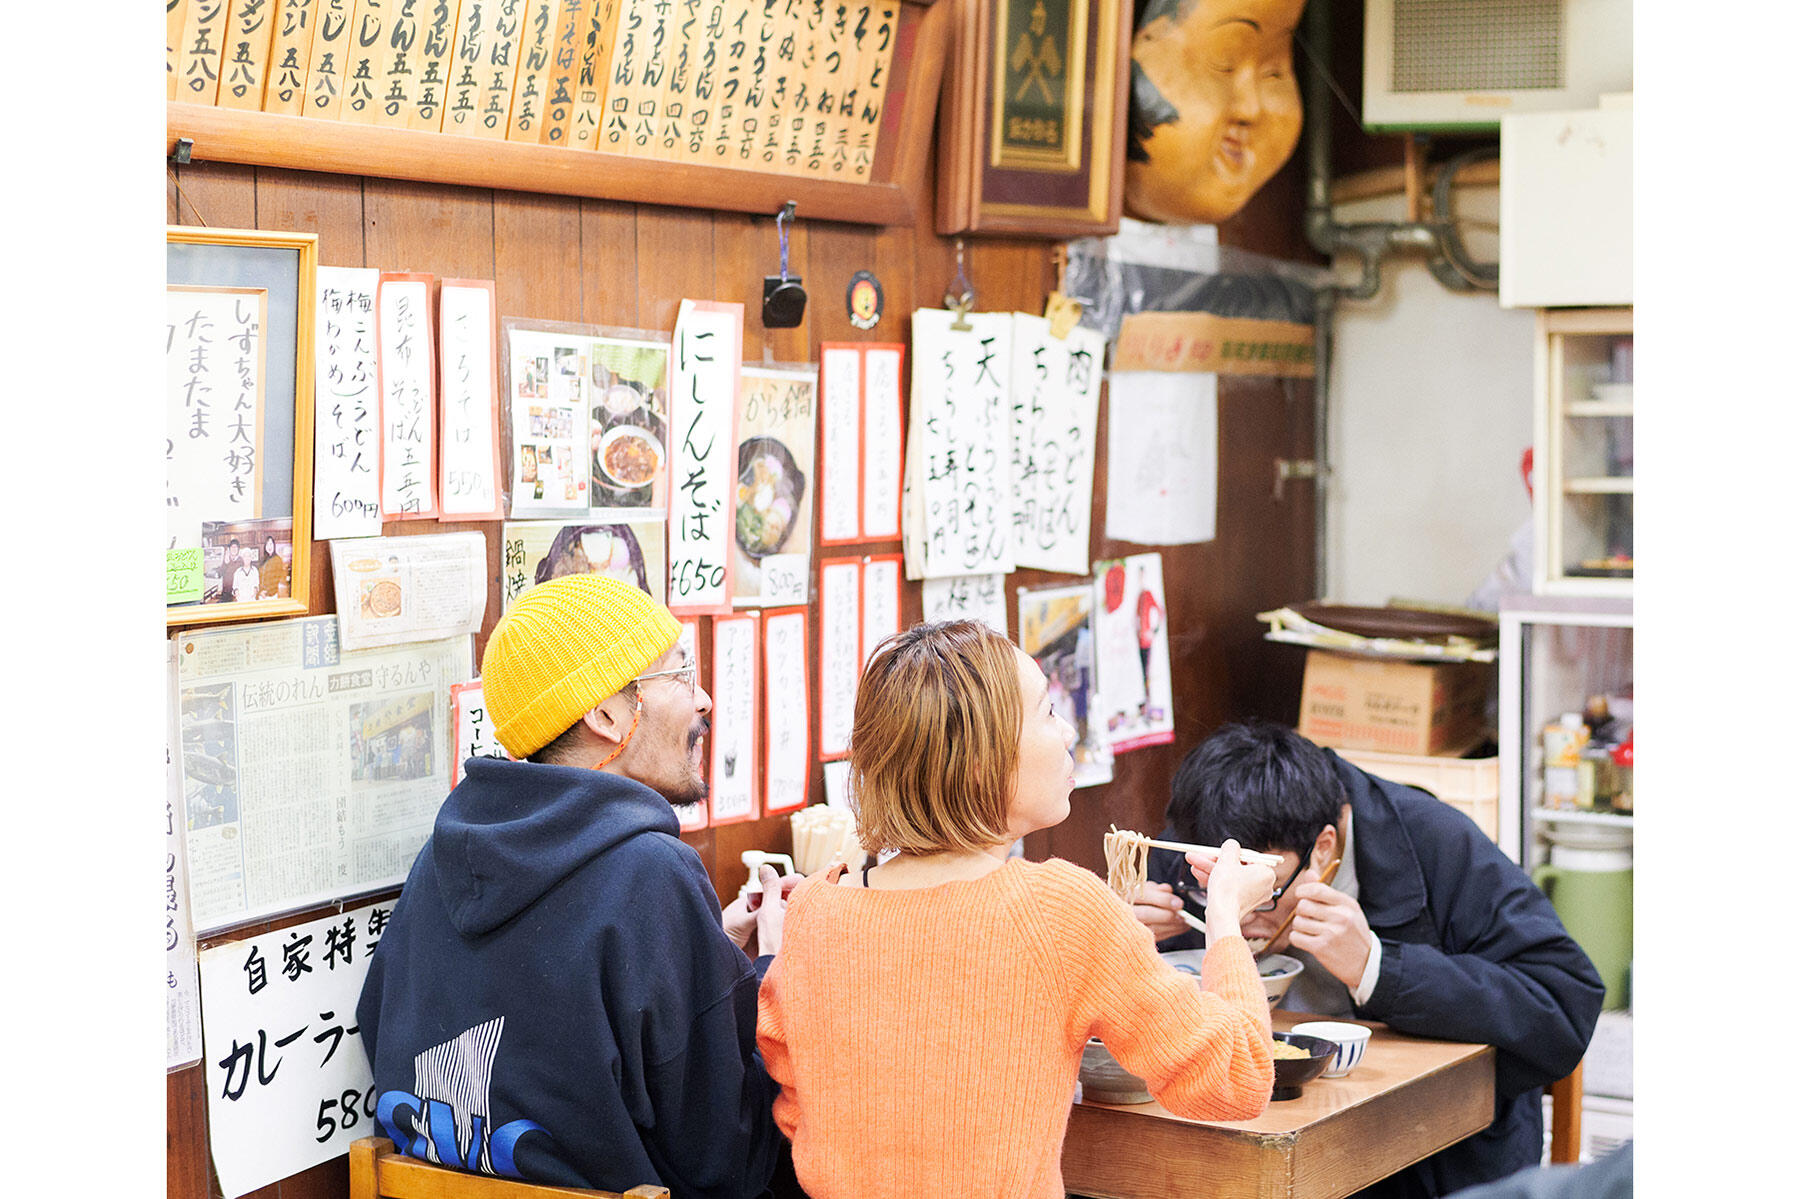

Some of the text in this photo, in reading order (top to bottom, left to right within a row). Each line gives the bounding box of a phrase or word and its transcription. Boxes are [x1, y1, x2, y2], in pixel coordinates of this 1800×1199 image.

[183, 310, 215, 440] たまたま
[223, 299, 259, 504] しずちゃん大好き
[680, 327, 721, 543] にしんそば
[331, 491, 379, 519] 600円
[243, 674, 323, 712] 伝統のれん
[375, 660, 432, 690] 守るんや
